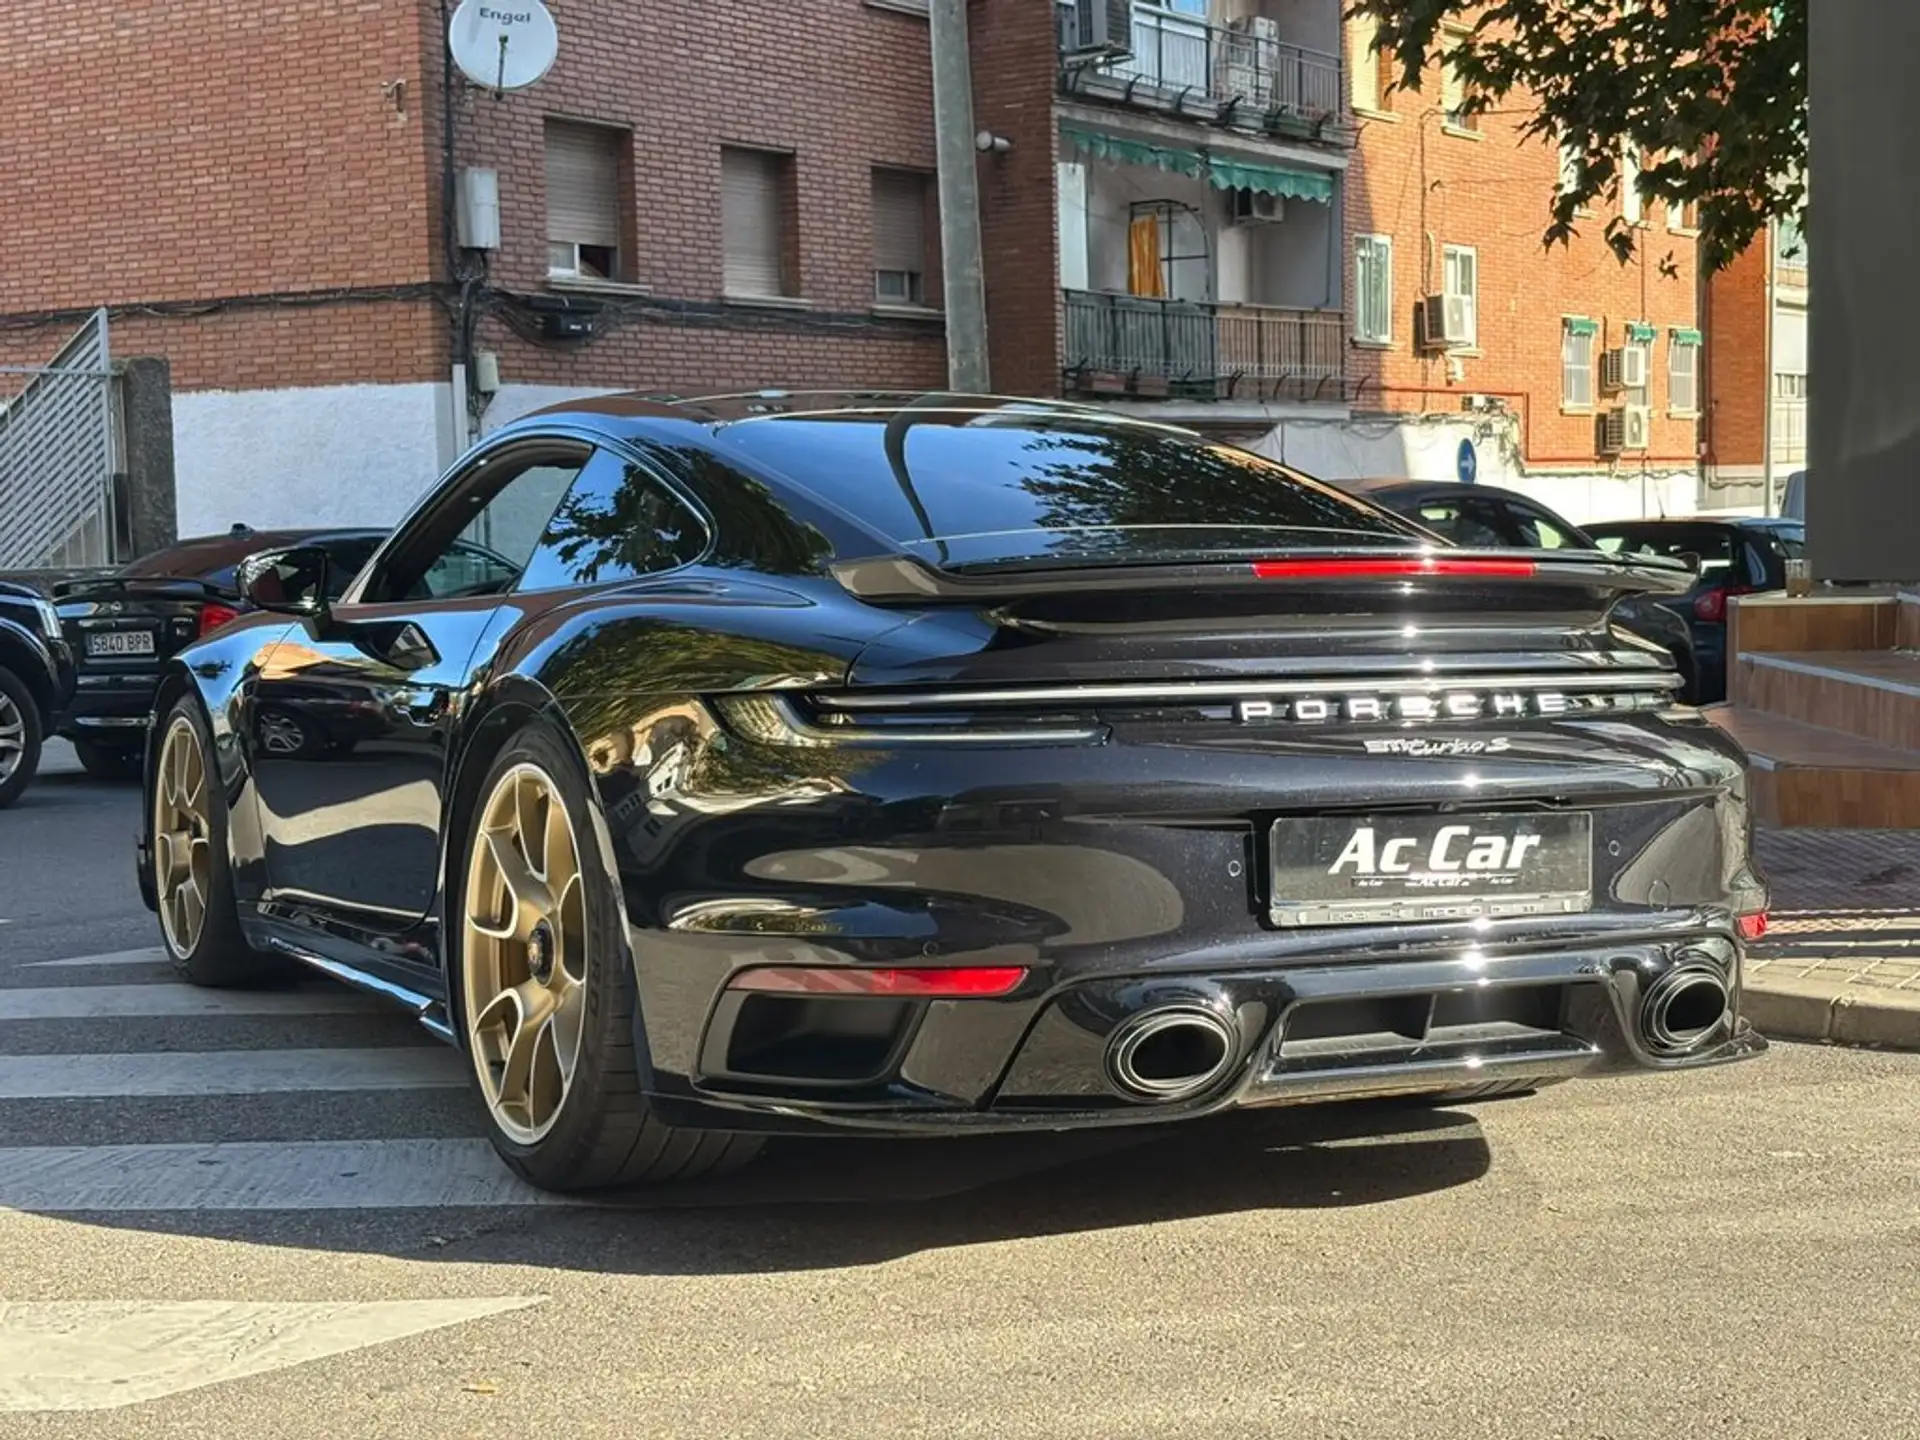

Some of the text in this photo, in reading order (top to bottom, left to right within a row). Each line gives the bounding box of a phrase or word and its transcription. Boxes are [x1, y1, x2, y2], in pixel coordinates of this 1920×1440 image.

[479, 7, 531, 25] Engel
[1239, 692, 1567, 723] PORSCHE
[1484, 737, 1512, 753] S
[1327, 825, 1541, 875] Ac Car
